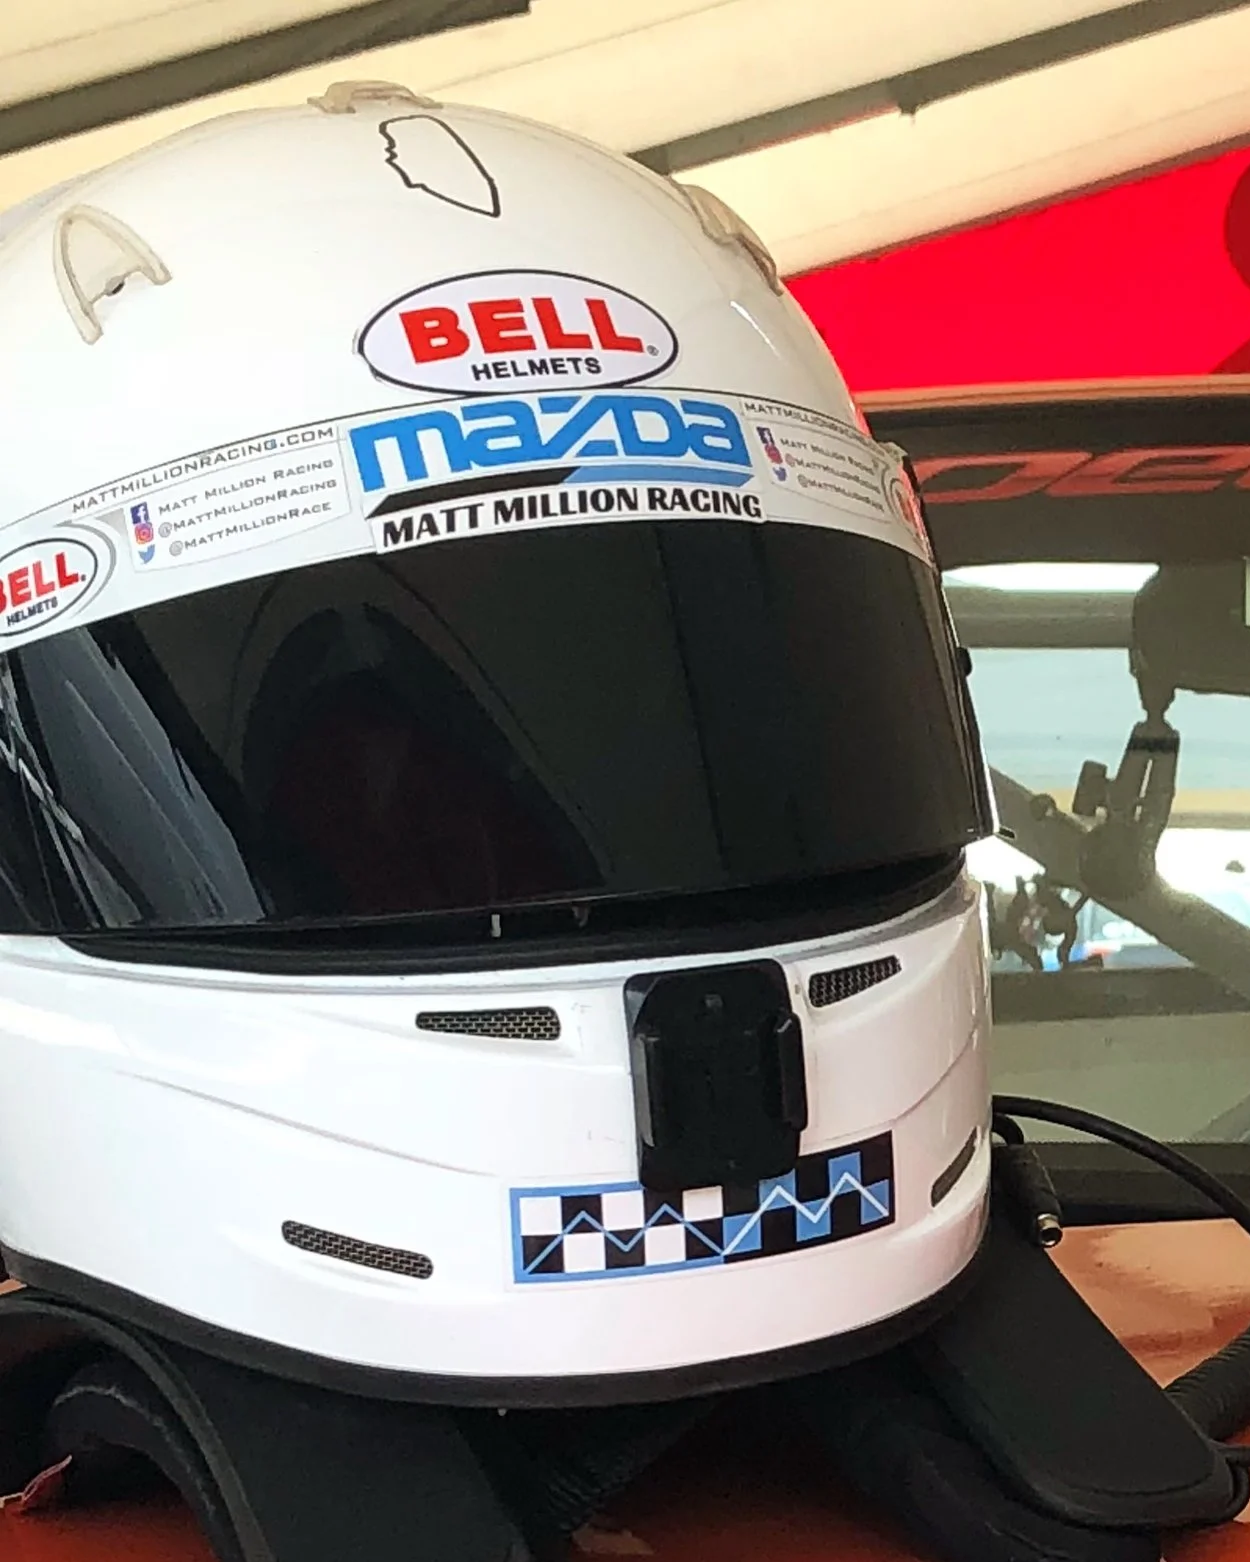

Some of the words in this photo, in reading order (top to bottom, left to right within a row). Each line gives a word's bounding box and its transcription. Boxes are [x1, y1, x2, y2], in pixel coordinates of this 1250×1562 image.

[400, 297, 644, 364] BELL
[471, 357, 602, 381] HELMETS
[72, 426, 335, 514] MATTMILLIONRACING.COM
[382, 502, 485, 548] MATT
[494, 487, 639, 523] MILLION
[648, 487, 762, 519] RACING
[0, 551, 79, 614] ELL
[6, 596, 59, 628] HELMETS
